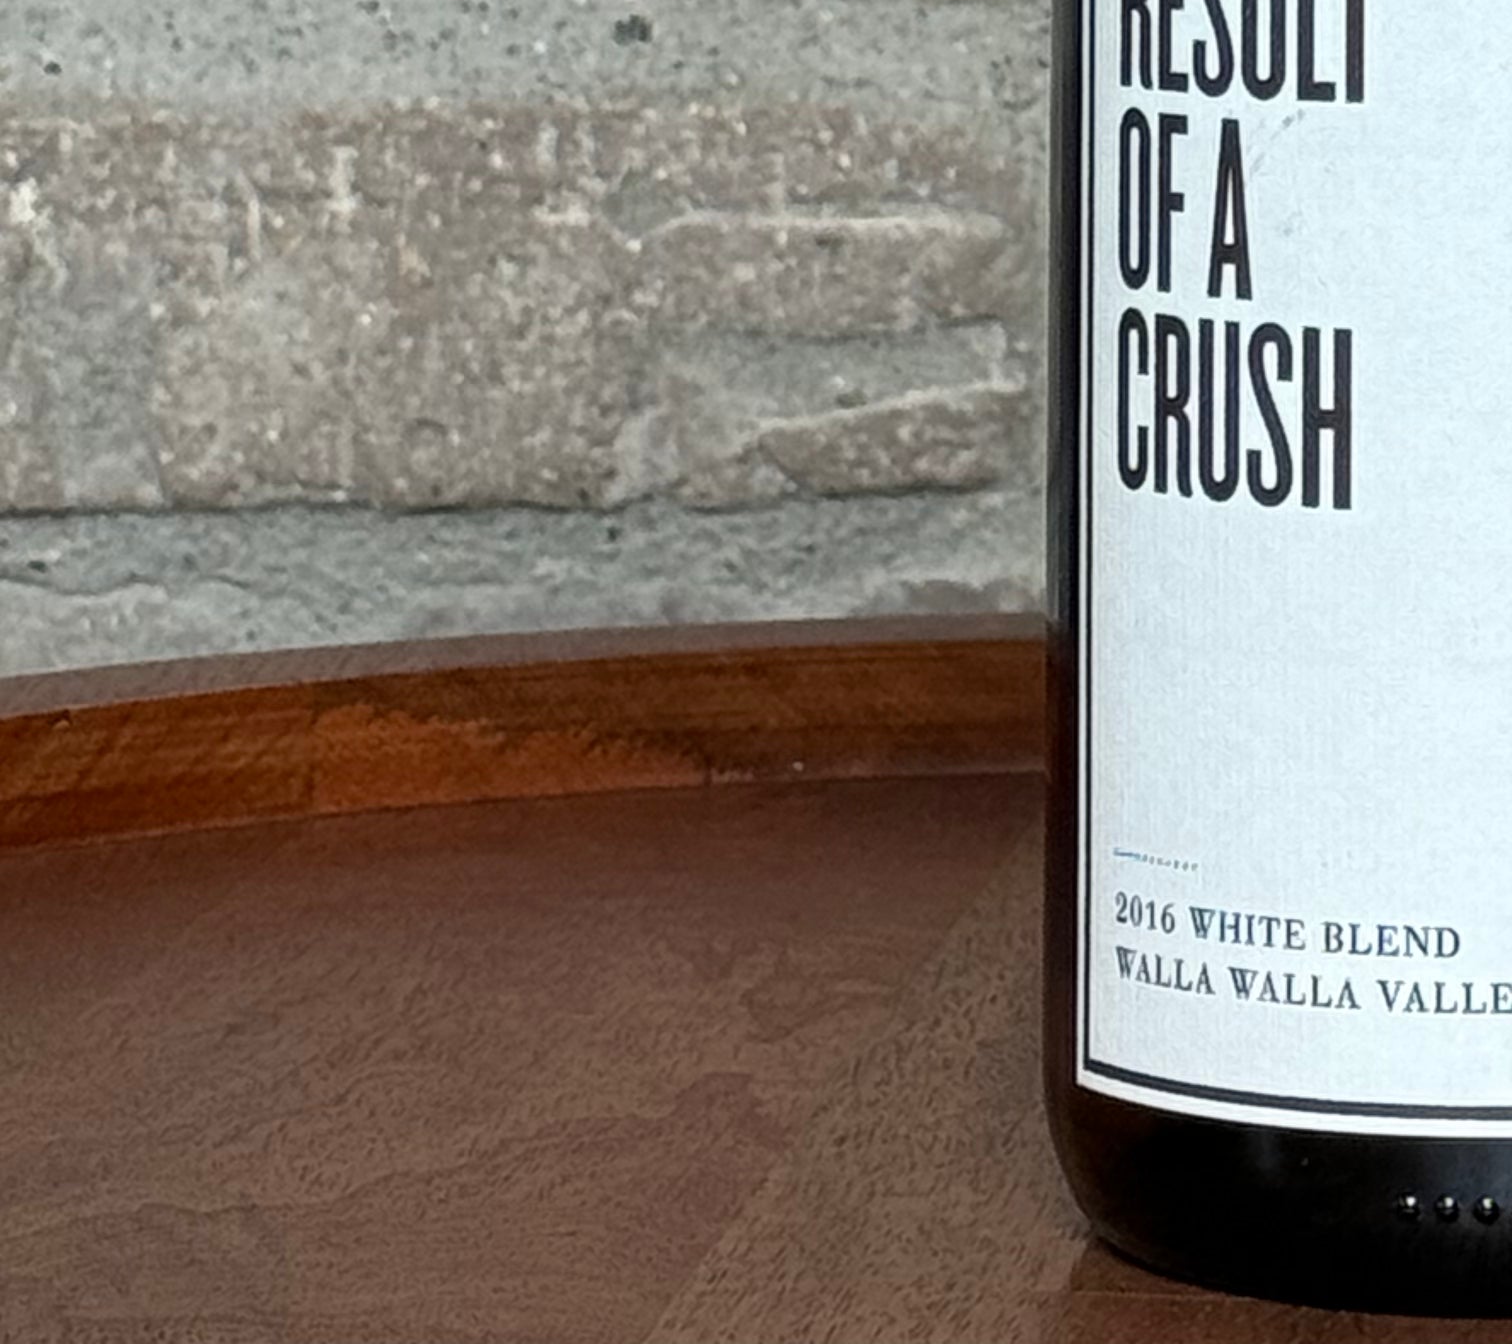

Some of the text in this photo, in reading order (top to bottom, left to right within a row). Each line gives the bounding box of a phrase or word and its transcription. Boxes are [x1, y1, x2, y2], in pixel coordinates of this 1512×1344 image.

[1118, 106, 1253, 301] OF A
[1117, 306, 1353, 510] CRUSH
[1115, 891, 1461, 958] 2016 WHITE BLEND
[1115, 945, 1215, 994] WALLA
[1228, 966, 1360, 1009] WALLA
